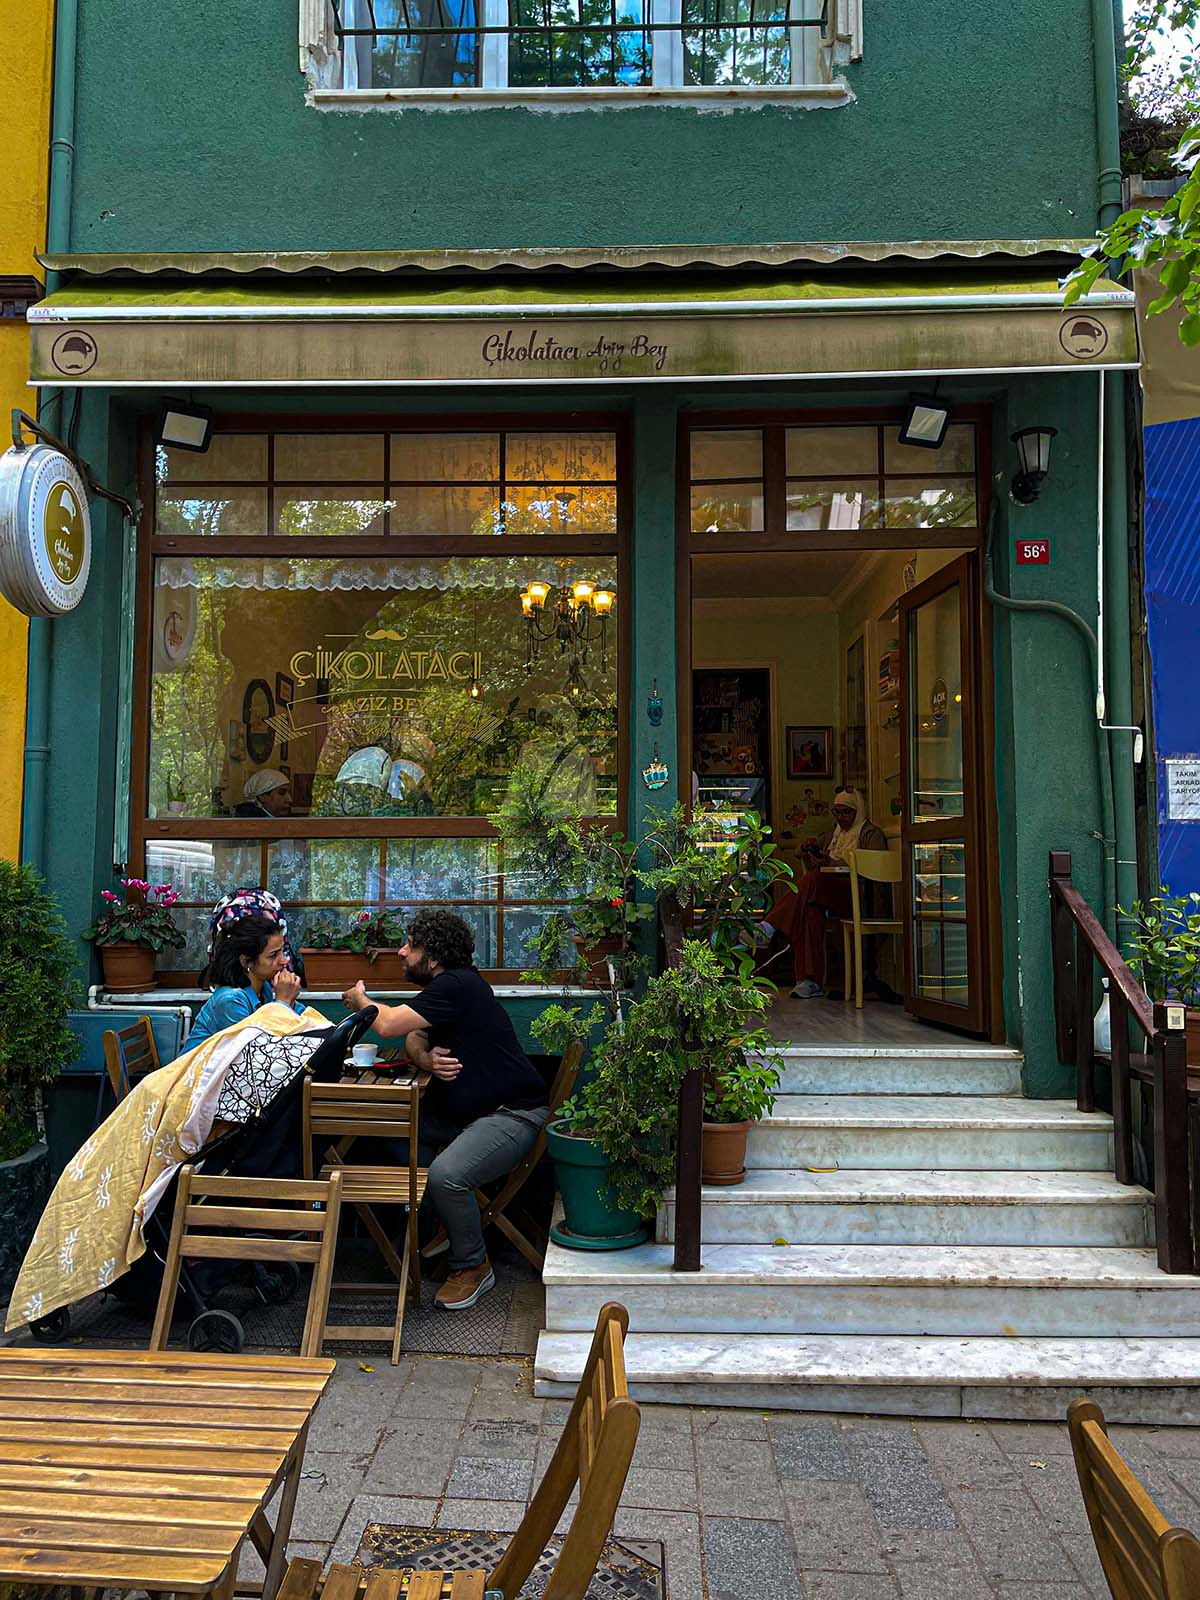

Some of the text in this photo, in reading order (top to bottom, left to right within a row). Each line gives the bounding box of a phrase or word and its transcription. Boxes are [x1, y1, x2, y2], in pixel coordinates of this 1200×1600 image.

[482, 330, 668, 371] Çikolatacı Aziz Bey
[1023, 544, 1046, 559] 56A
[290, 645, 482, 687] ÇİKOLATACI
[344, 693, 429, 714] AZİZ BEY
